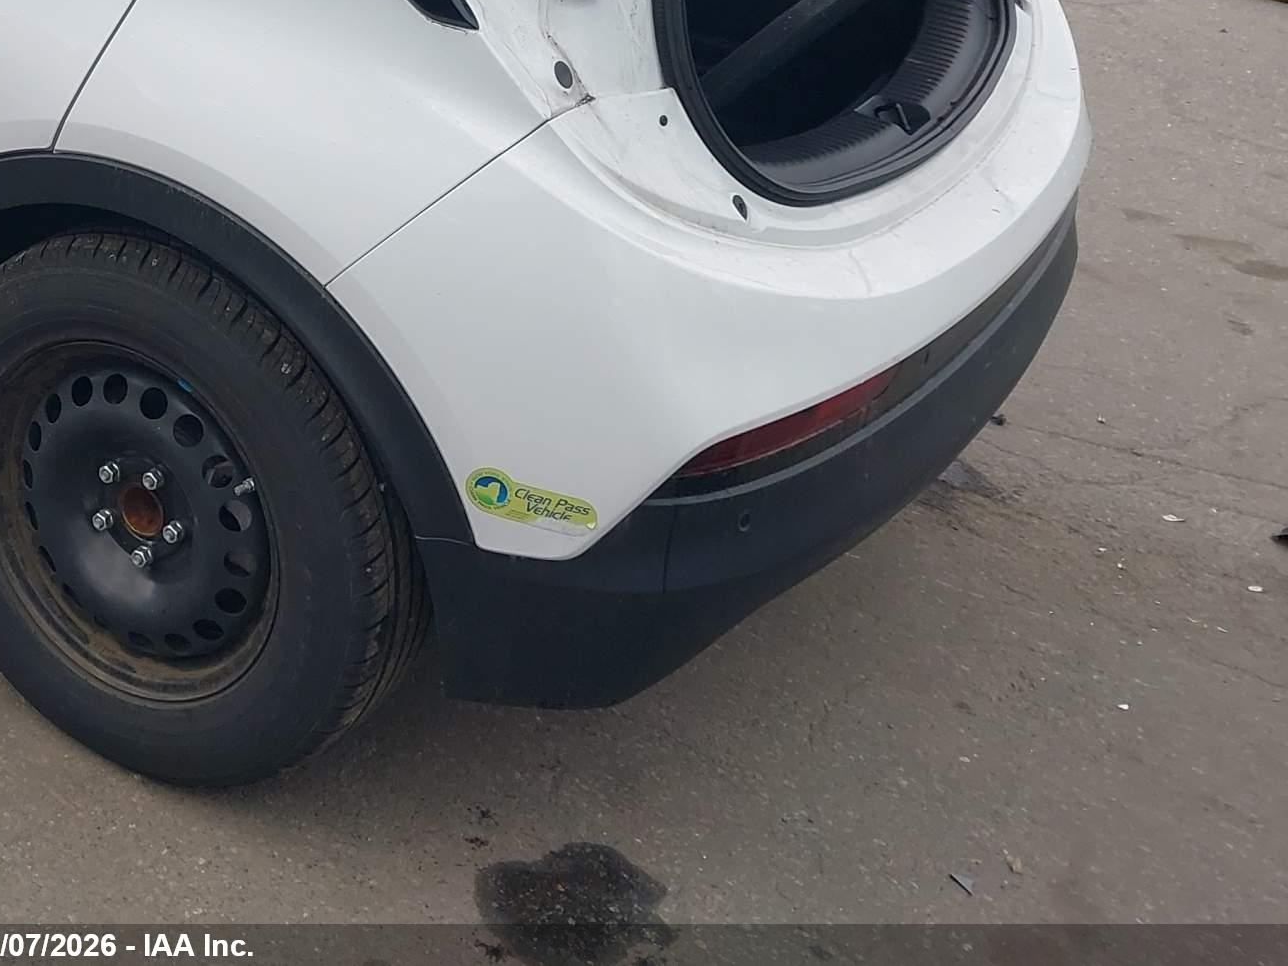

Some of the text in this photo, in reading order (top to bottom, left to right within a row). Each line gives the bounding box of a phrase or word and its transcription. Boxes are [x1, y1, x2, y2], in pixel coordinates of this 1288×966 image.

[514, 488, 552, 507] Clean
[554, 498, 591, 516] Pass
[526, 501, 573, 522] Vehicle
